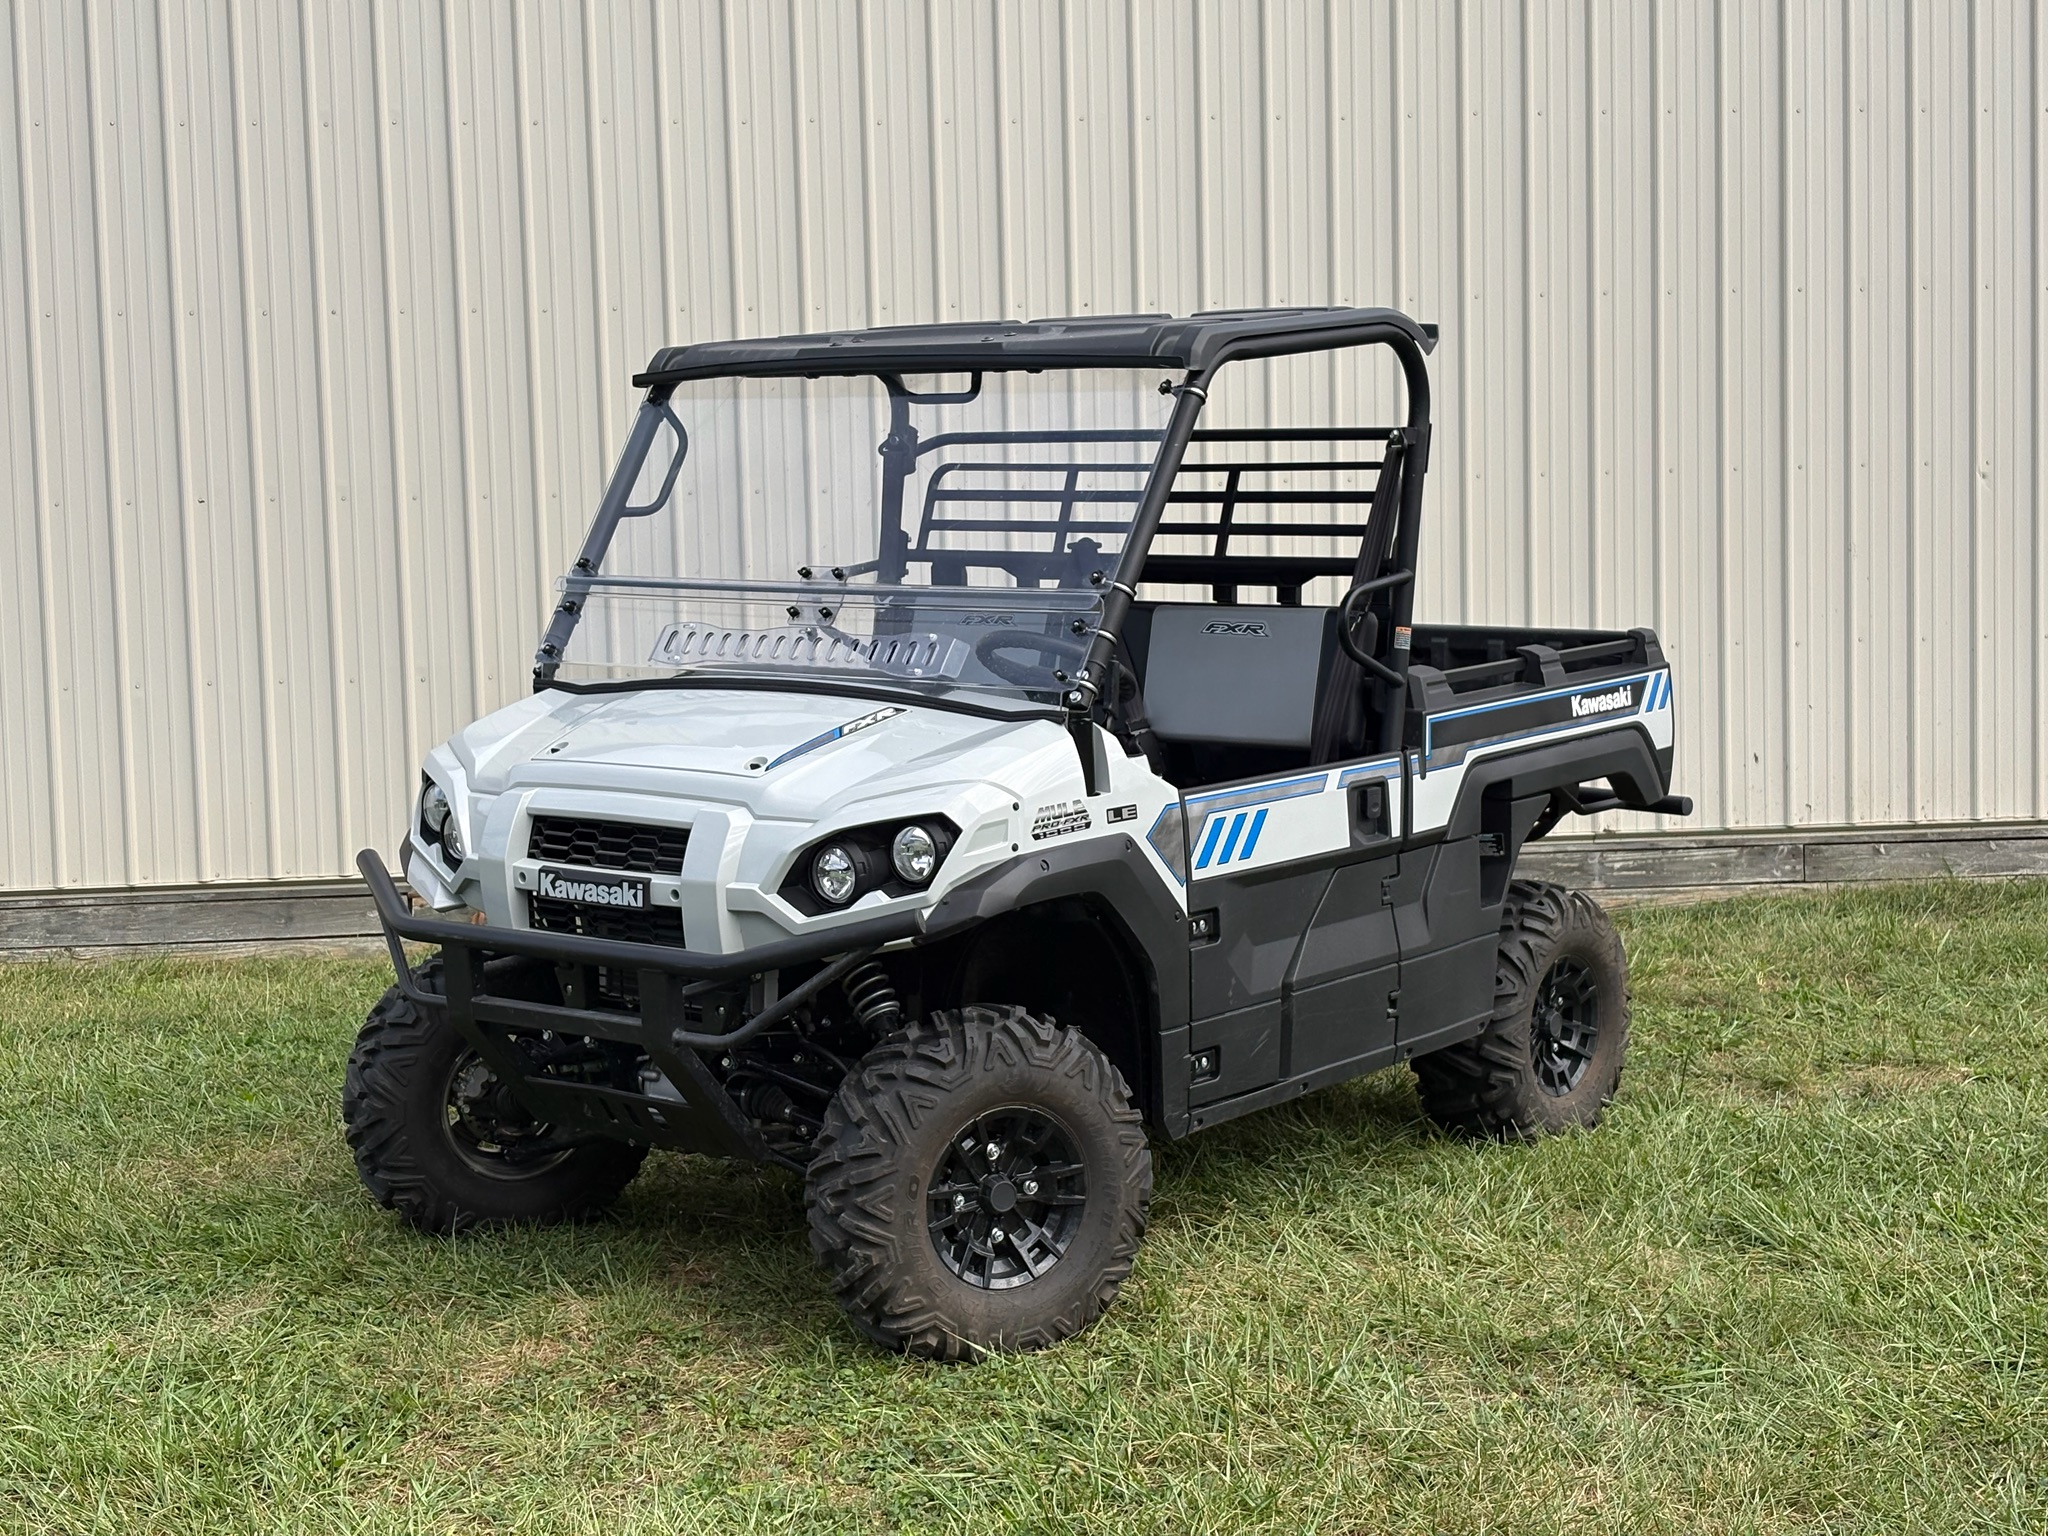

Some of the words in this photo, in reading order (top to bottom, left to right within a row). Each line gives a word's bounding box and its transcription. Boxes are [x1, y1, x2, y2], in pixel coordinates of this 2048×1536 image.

[961, 613, 1016, 627] FXR
[1202, 621, 1267, 637] FXR
[1570, 685, 1632, 718] Kawasaki
[843, 706, 898, 736] FXR
[1034, 799, 1088, 824] MULE
[1107, 806, 1136, 823] LE
[540, 872, 643, 908] Kawasaki
